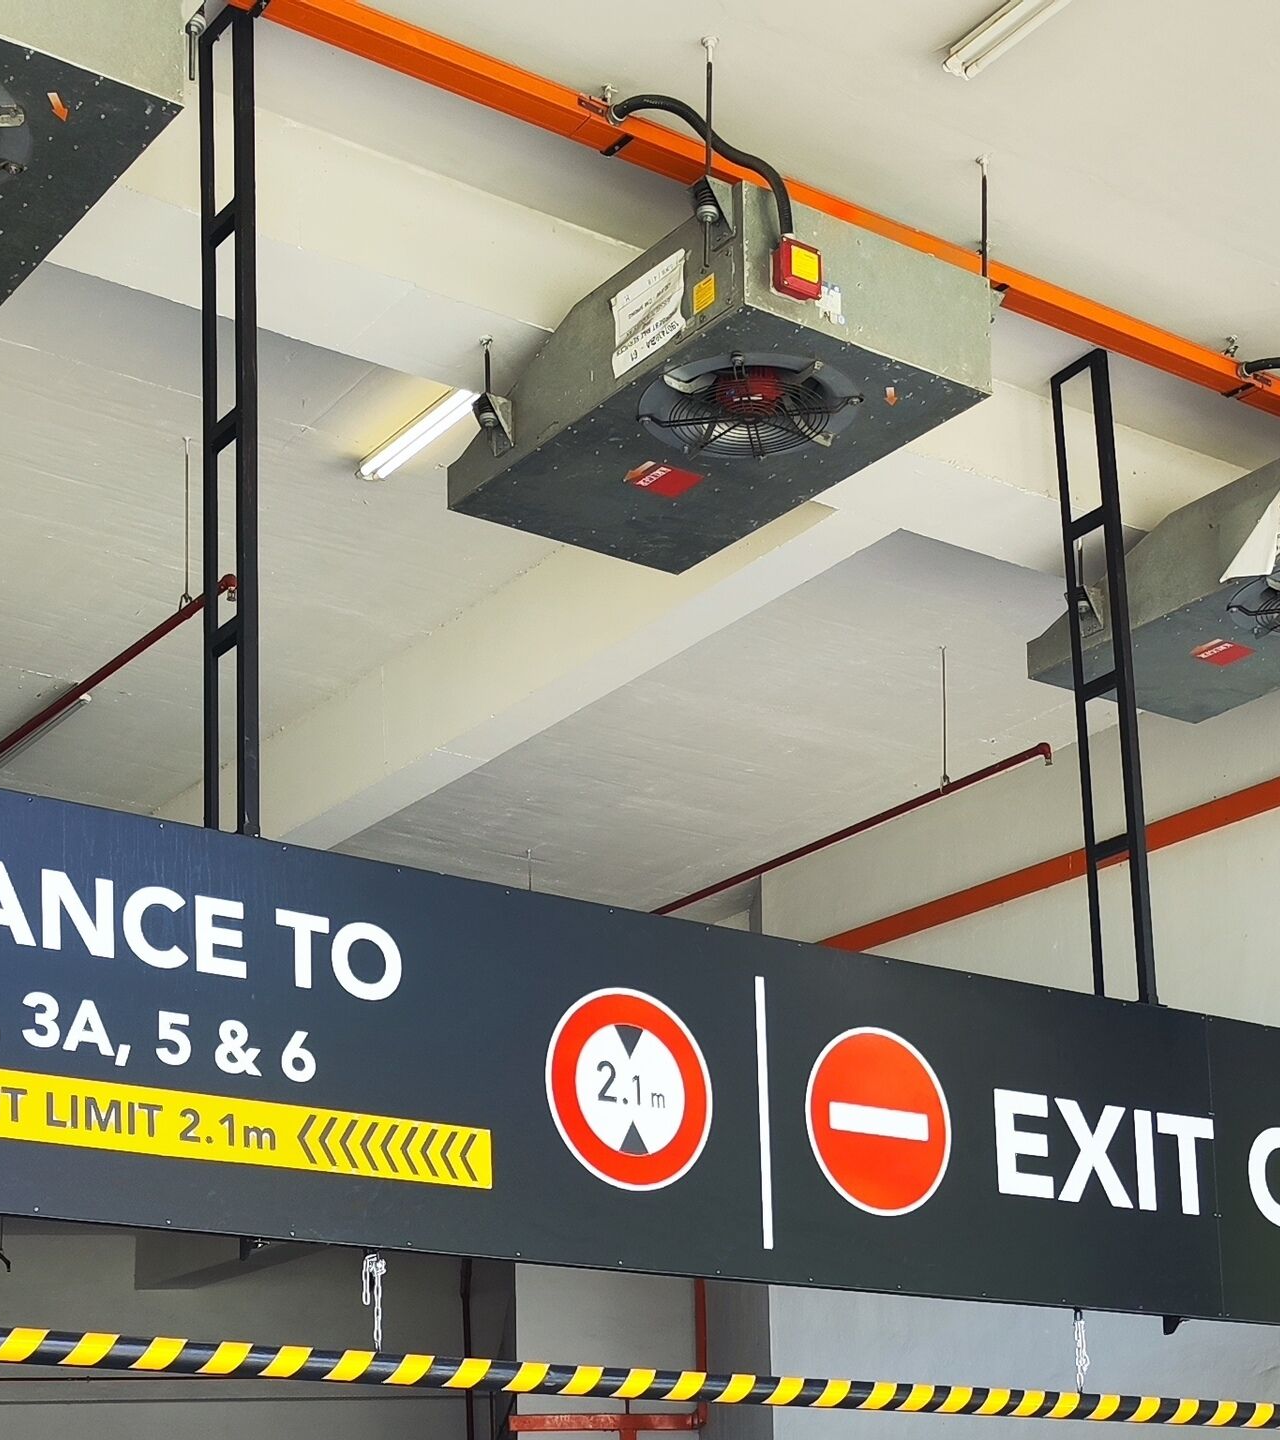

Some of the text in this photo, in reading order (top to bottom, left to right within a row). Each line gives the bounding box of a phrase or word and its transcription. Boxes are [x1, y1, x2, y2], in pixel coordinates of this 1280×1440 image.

[276, 908, 402, 1001] TO
[21, 992, 131, 1067] 3A,
[156, 1011, 191, 1065] 5
[215, 1020, 262, 1077] &
[281, 1031, 317, 1083] 6
[47, 1091, 163, 1138] LIMIT
[179, 1107, 277, 1151] 2.1m
[994, 1088, 1214, 1216] EXIT
